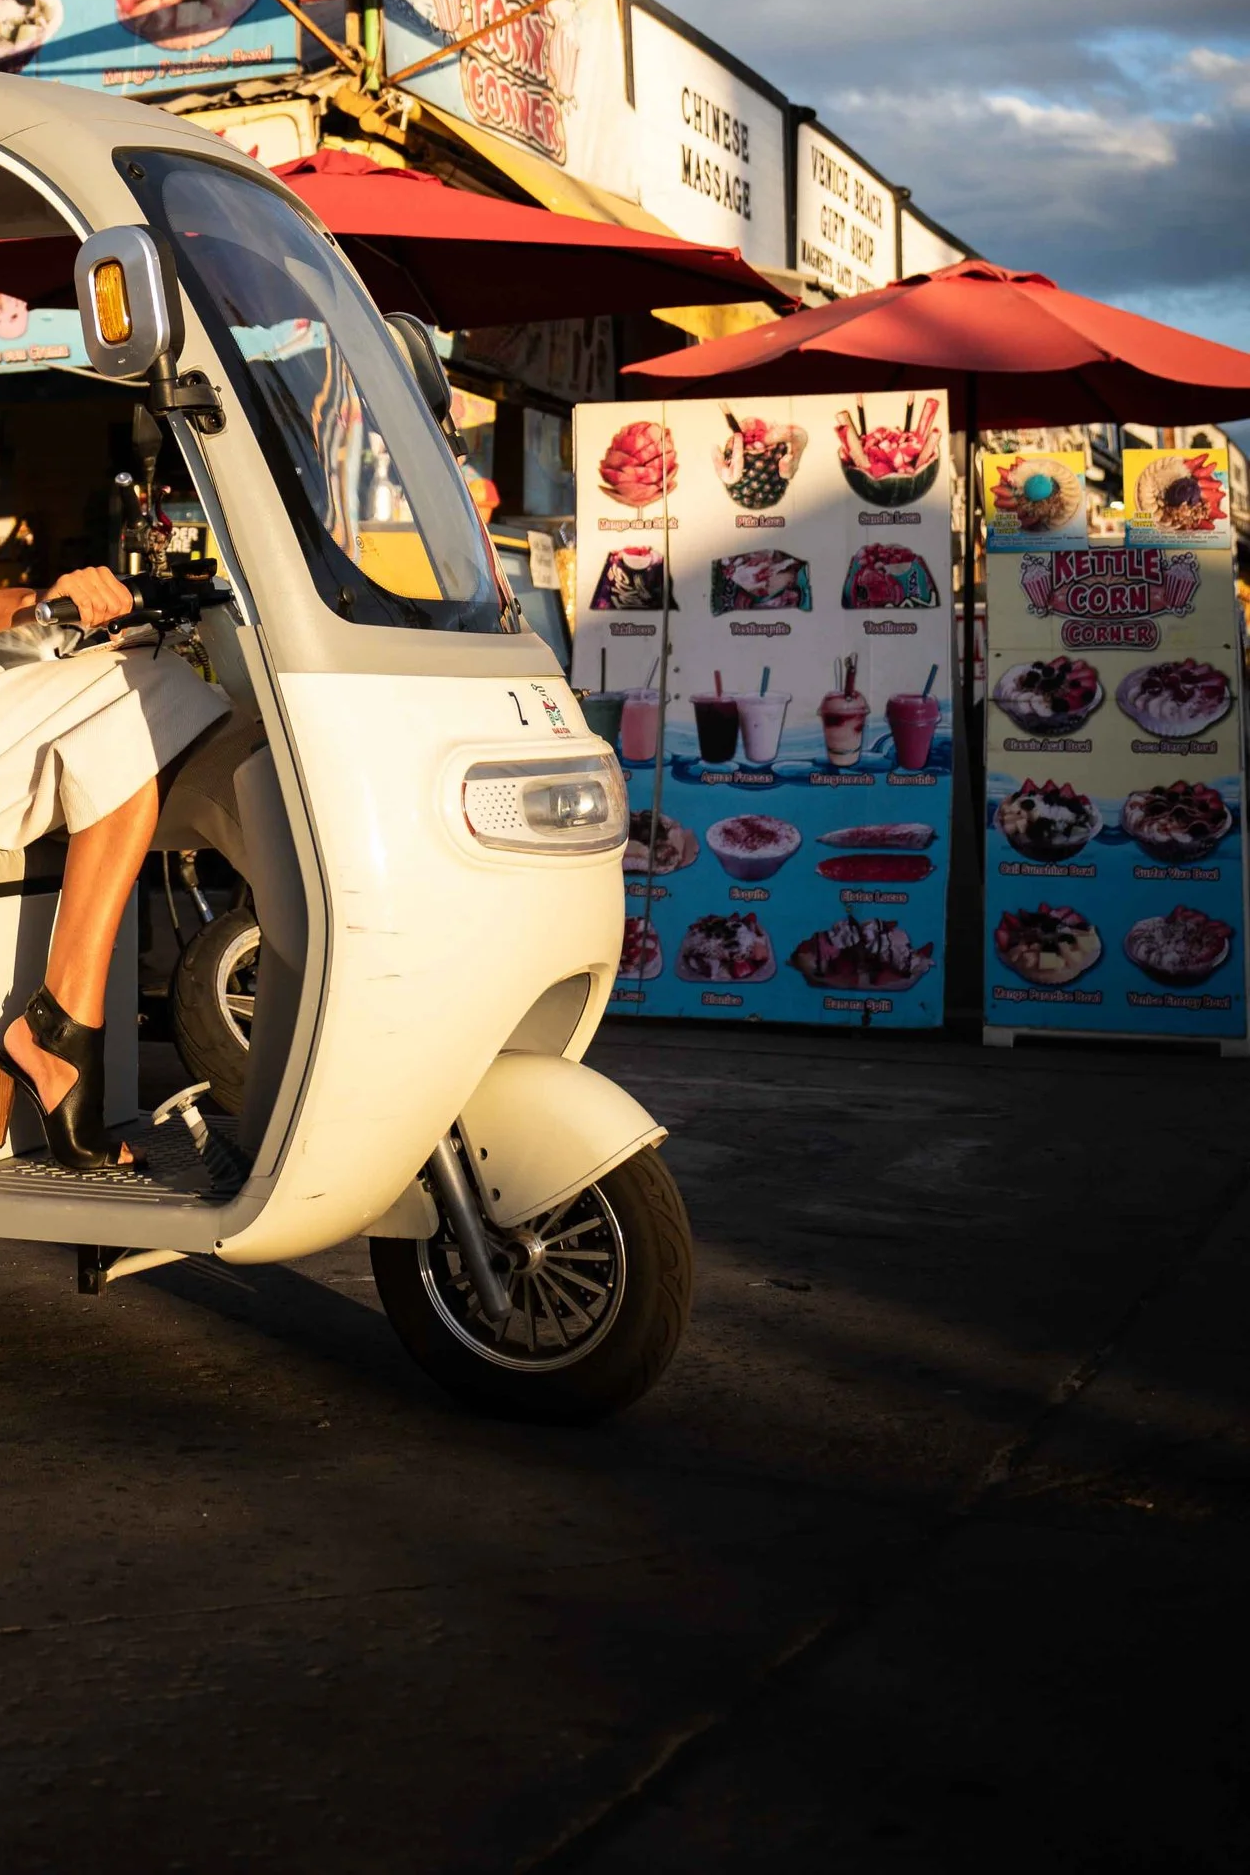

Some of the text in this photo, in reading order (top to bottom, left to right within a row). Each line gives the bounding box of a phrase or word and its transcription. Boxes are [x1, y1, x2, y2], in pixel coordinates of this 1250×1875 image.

[232, 44, 273, 68] Bowl
[466, 58, 562, 158] CORNER
[681, 87, 749, 164] CHINESE
[681, 143, 752, 221] MASSAGE
[811, 145, 883, 230] VENICE BEACH
[820, 204, 874, 268] GIFT SHOP
[1052, 547, 1164, 588] KETTLE
[1067, 584, 1150, 614] CORN
[1064, 624, 1154, 645] CORNER
